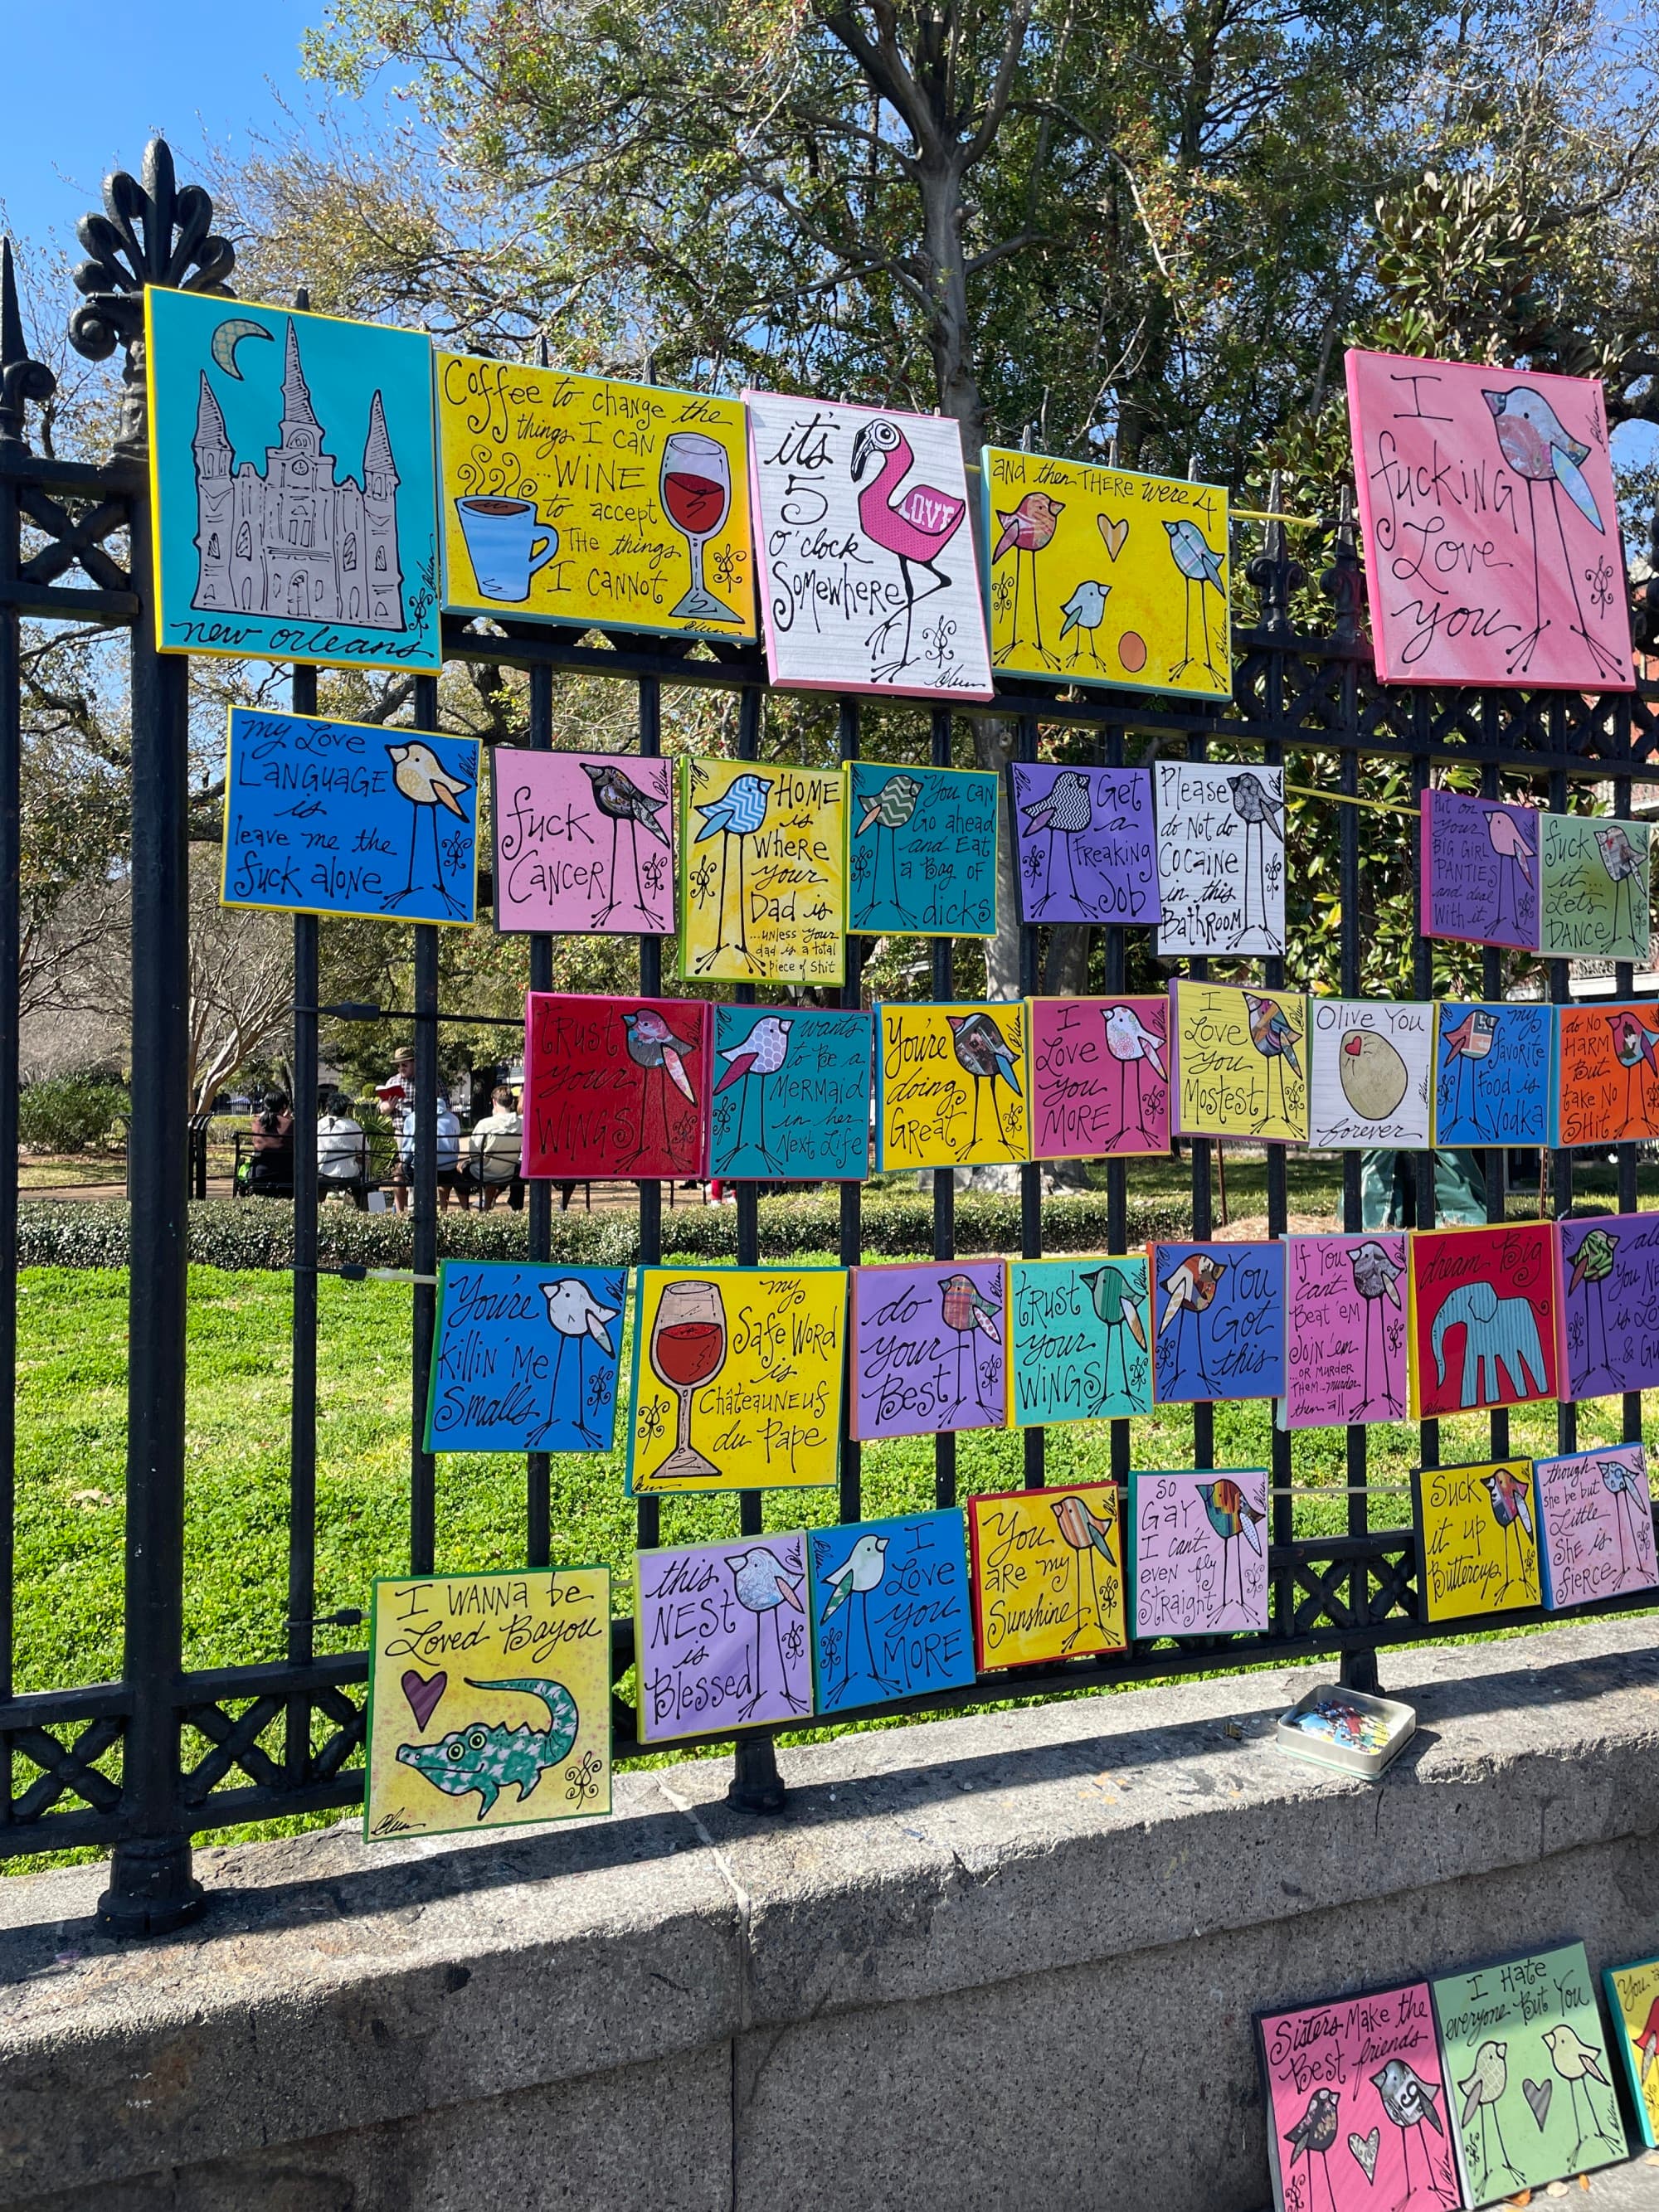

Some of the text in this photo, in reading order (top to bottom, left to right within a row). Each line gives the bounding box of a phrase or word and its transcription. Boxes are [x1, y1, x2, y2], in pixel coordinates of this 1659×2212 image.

[445, 359, 732, 444] Coffee to the
[1390, 375, 1453, 421] I
[517, 413, 603, 459] things I
[764, 411, 839, 469] it's
[543, 494, 658, 535] to accept
[781, 474, 828, 524] 5
[897, 493, 954, 529] LOVE
[1034, 463, 1077, 484] then
[1142, 483, 1189, 503] were
[1193, 489, 1217, 532] 4
[609, 534, 681, 568] things
[1392, 516, 1513, 594] Love
[547, 561, 575, 593] I
[170, 620, 434, 658] new orleans
[1391, 600, 1521, 664] you
[241, 719, 365, 759] my Love
[274, 793, 327, 818] is
[1097, 772, 1144, 811] Get
[1161, 766, 1229, 810] Please
[1435, 794, 1477, 814] Put on
[235, 814, 397, 855] leave me the
[780, 809, 813, 827] is
[912, 804, 995, 834] Go ahead
[1094, 817, 1139, 832] a
[1161, 813, 1238, 837] do do
[898, 836, 990, 857] and Eat
[752, 864, 828, 891] your
[901, 857, 956, 890] a Bag
[1434, 858, 1497, 887] PANTIES
[751, 892, 833, 923] Dad is
[1098, 872, 1146, 916] Job
[1160, 879, 1236, 903] in this
[1433, 885, 1493, 903] and deal
[1467, 906, 1486, 924] it
[756, 941, 835, 957] dad is a total
[770, 958, 806, 980] piece of
[1057, 1005, 1081, 1031] I
[1199, 992, 1221, 1012] I
[1316, 1004, 1375, 1030] Olive
[1385, 1008, 1424, 1034] You
[799, 1014, 868, 1038] wants
[1185, 1016, 1248, 1049] Love
[1507, 1009, 1542, 1041] my
[1562, 1015, 1584, 1033] do
[787, 1042, 865, 1072] to Be a
[1036, 1037, 1099, 1077] Love
[1184, 1051, 1253, 1074] you
[1568, 1057, 1610, 1082] But
[887, 1067, 966, 1116] doing
[1039, 1077, 1107, 1106] you
[1184, 1075, 1263, 1125] Mostest
[1478, 1068, 1540, 1097] Food is
[771, 1107, 864, 1128] in her
[1041, 1104, 1112, 1147] MORE
[1316, 1118, 1422, 1147] forever
[776, 1128, 862, 1169] Next Life
[1228, 1252, 1277, 1302] You
[1295, 1242, 1346, 1283] If You
[1420, 1241, 1491, 1291] dream
[1492, 1231, 1543, 1288] Big
[759, 1279, 805, 1313] my
[861, 1285, 932, 1326] do
[1212, 1300, 1280, 1344] Got
[1289, 1303, 1330, 1332] Beat
[1609, 1303, 1630, 1330] is
[733, 1306, 786, 1369] Safe
[1016, 1333, 1096, 1366] your
[750, 1357, 797, 1383] is
[860, 1335, 970, 1378] your
[1212, 1343, 1278, 1378] this
[434, 1382, 540, 1432] Smalls
[861, 1364, 951, 1425] Best
[1291, 1393, 1344, 1418] them all
[713, 1418, 827, 1473] du Pape
[1543, 1456, 1596, 1487] though
[1431, 1473, 1481, 1507] Suck
[1544, 1480, 1600, 1509] she be but
[1427, 1515, 1486, 1556] it up
[1550, 1503, 1611, 1536] Little
[903, 1522, 935, 1554] I
[982, 1511, 1054, 1568] You
[1139, 1534, 1159, 1561] I
[1588, 1528, 1612, 1556] is
[645, 1557, 719, 1599] this
[885, 1558, 955, 1596] Love
[1036, 1557, 1070, 1592] my
[1188, 1553, 1217, 1591] fly
[1428, 1554, 1501, 1603] Buttercup
[395, 1584, 433, 1621] I
[546, 1572, 594, 1607] be
[874, 1596, 961, 1638] you
[987, 1593, 1091, 1649] Sunshine
[385, 1614, 601, 1666] Loved Bayou
[673, 1640, 709, 1669] is
[884, 1629, 962, 1689] MORE
[645, 1644, 752, 1725] Blessed
[1467, 1958, 1546, 2001] I Hate
[1618, 1977, 1650, 2011] You
[1446, 2004, 1511, 2047] everyone
[1553, 1969, 1589, 2017] You
[1270, 1991, 1428, 2066] Sisters Make the
[1278, 2025, 1428, 2102] Best friends
